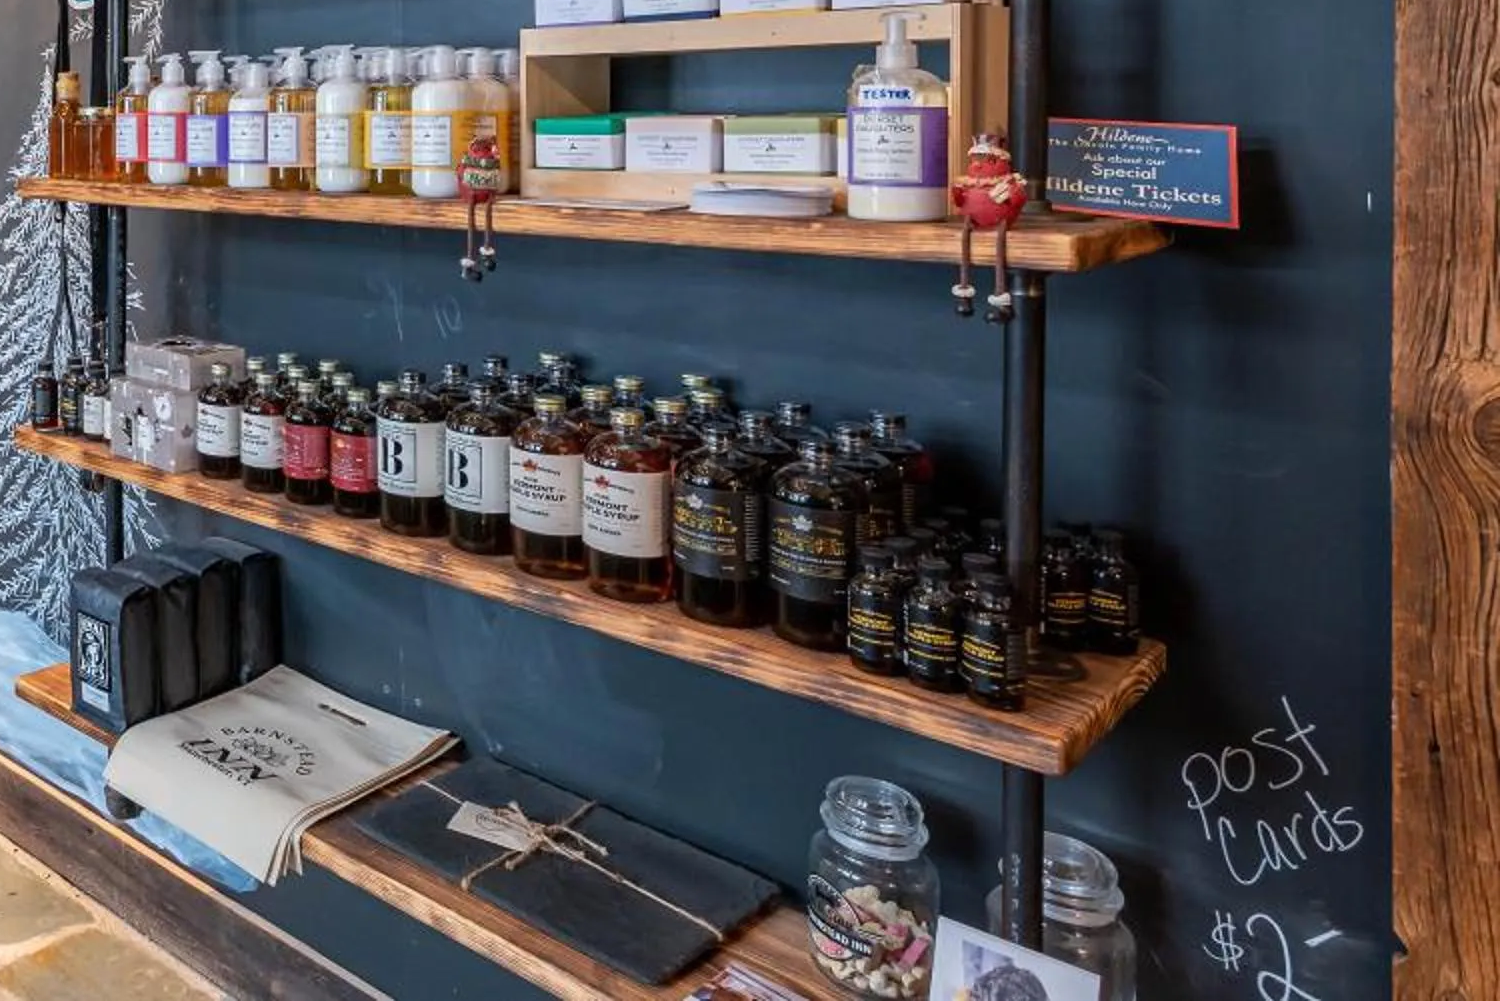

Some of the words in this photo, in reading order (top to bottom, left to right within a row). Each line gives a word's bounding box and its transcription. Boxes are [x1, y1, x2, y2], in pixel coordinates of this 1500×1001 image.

[862, 89, 912, 101] TESTER
[1077, 125, 1170, 146] Hildene
[1167, 144, 1202, 155] Home
[1083, 151, 1105, 163] Ask
[1107, 154, 1143, 166] about
[1145, 157, 1167, 167] our
[1091, 161, 1158, 181] Special
[1131, 182, 1222, 206] Tickets
[381, 435, 404, 477] B
[447, 448, 469, 490] B
[531, 492, 567, 503] SYRUP
[603, 510, 641, 522] SYRUP
